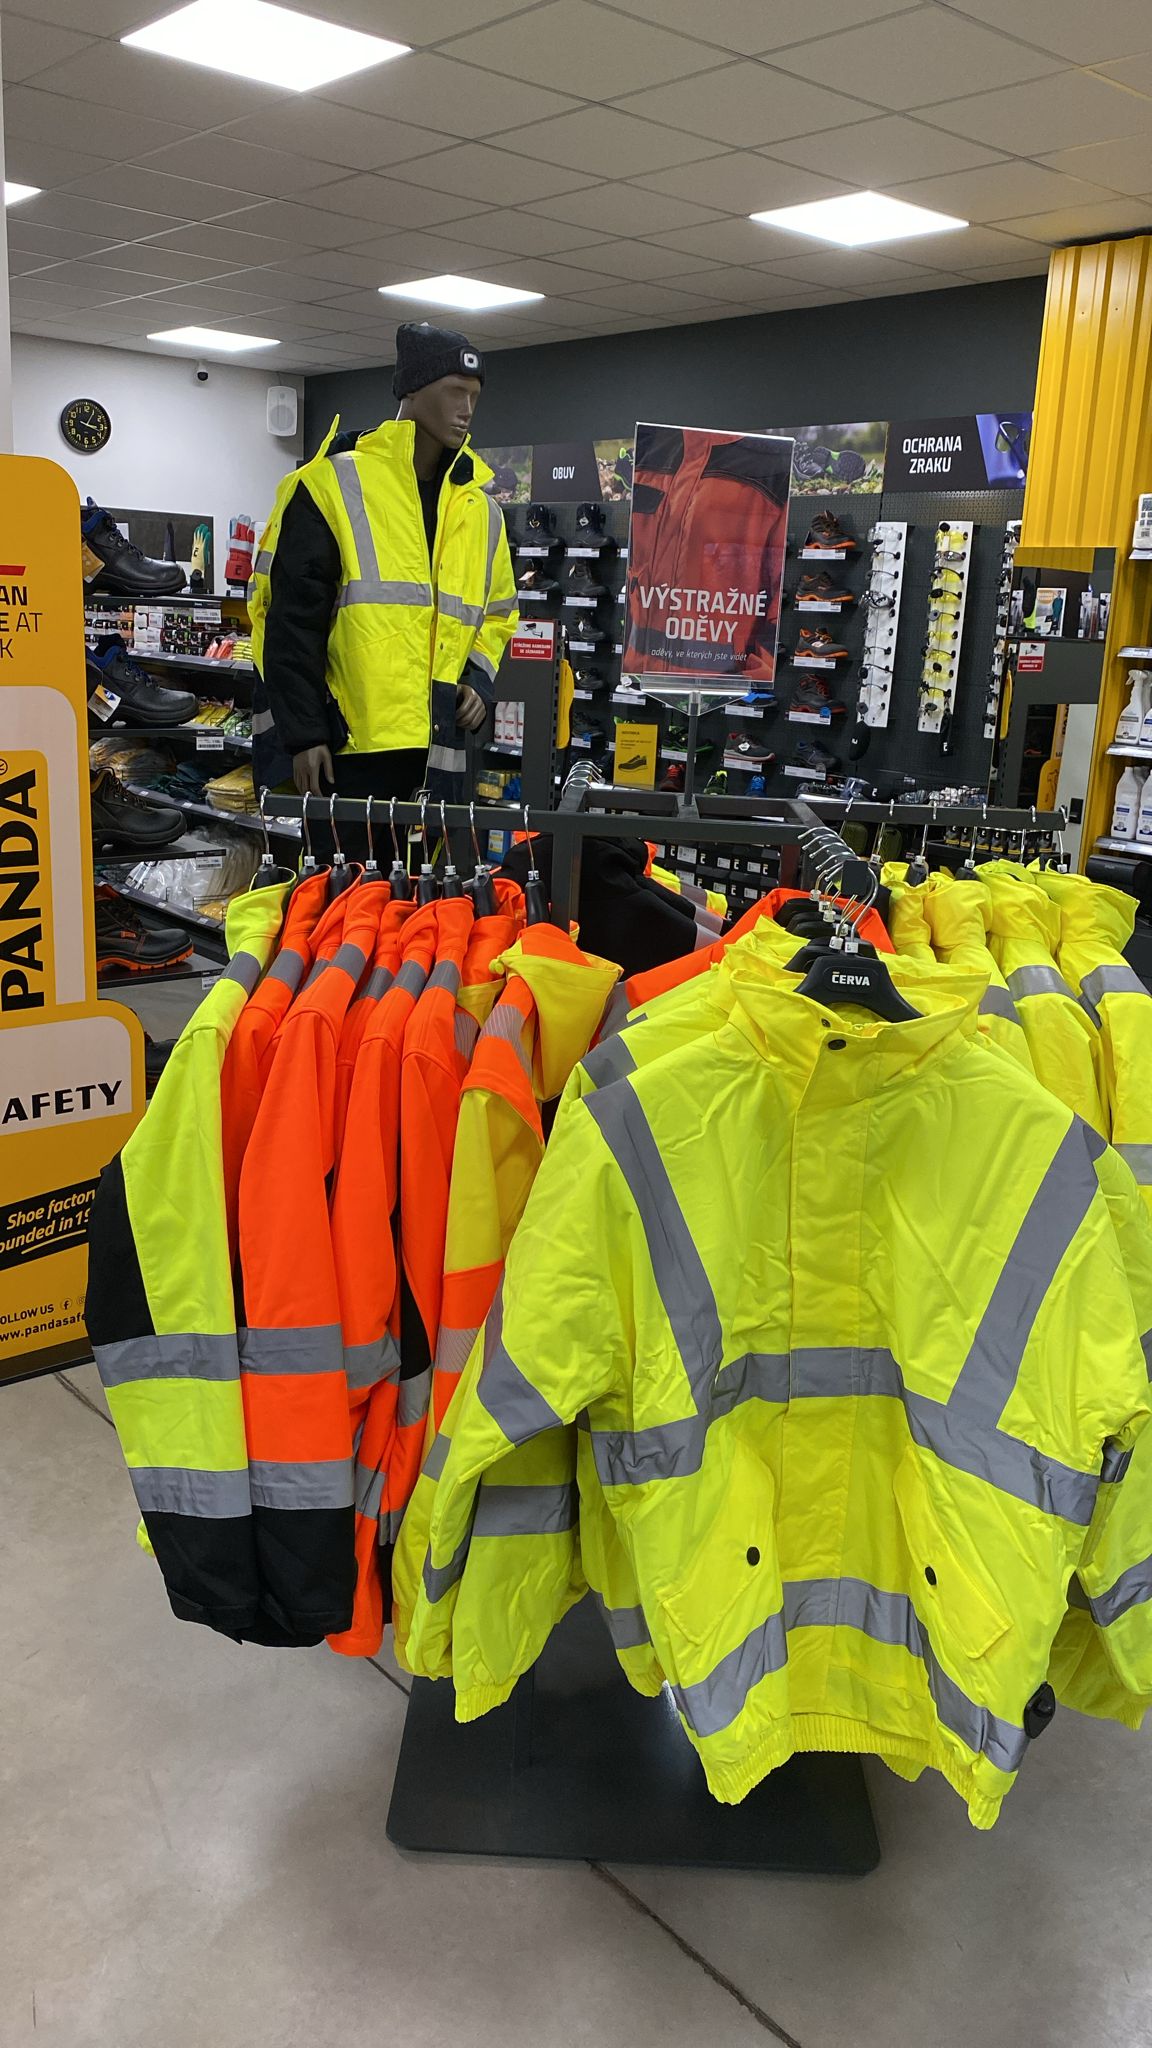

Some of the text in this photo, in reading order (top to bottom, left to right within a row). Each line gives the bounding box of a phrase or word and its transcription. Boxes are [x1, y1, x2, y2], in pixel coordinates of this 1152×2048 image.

[903, 436, 962, 454] OCHRANA
[553, 466, 575, 479] OBUV
[909, 457, 952, 473] ZRAKU
[640, 583, 767, 616] VÝSTRAŽNÉ
[16, 612, 42, 632] AT
[665, 614, 738, 642] ODĚVY
[651, 648, 673, 658] oděvy,
[676, 650, 684, 658] ve
[686, 649, 712, 660] kterých
[713, 651, 728, 661] jste
[0, 769, 44, 1011] PANDA
[2, 1080, 122, 1124] AFETY
[7, 1207, 45, 1230] Shoe
[59, 1216, 73, 1232] in
[0, 1304, 54, 1325] OLLOW US
